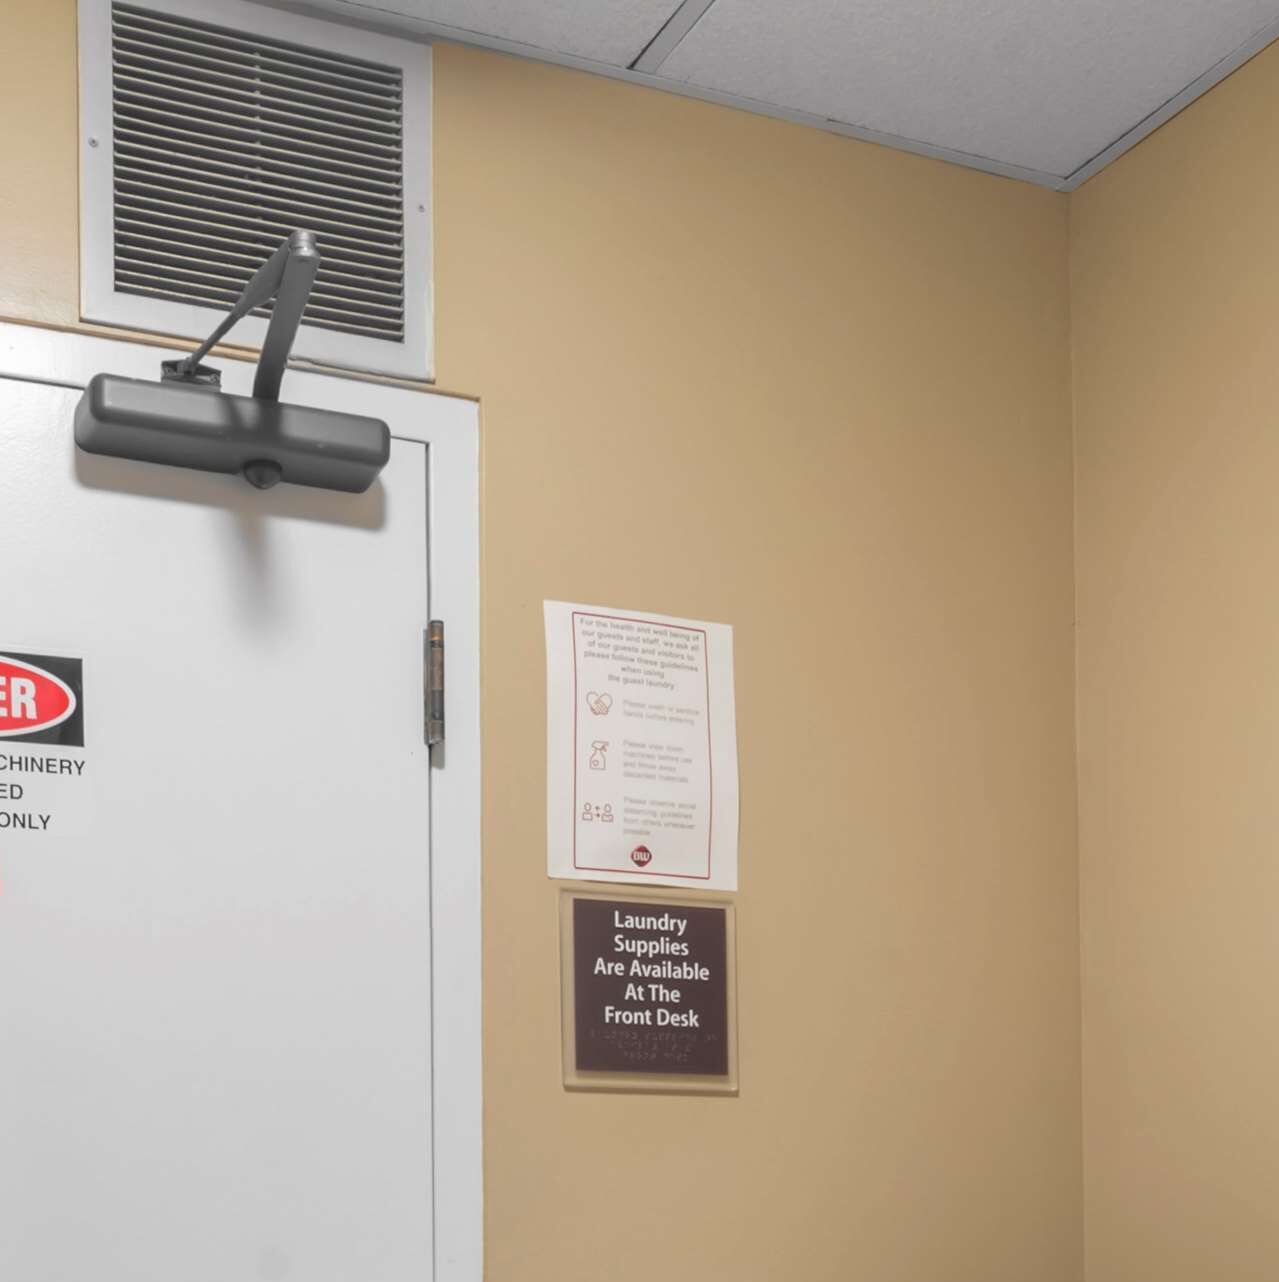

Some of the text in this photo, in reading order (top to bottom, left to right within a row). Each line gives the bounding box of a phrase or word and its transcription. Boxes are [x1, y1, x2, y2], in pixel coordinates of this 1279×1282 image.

[614, 909, 688, 937] Laundry
[613, 934, 690, 959] Supplies
[593, 956, 711, 982] Are Available
[624, 982, 681, 1004] At The
[604, 1005, 700, 1029] Front Desk
